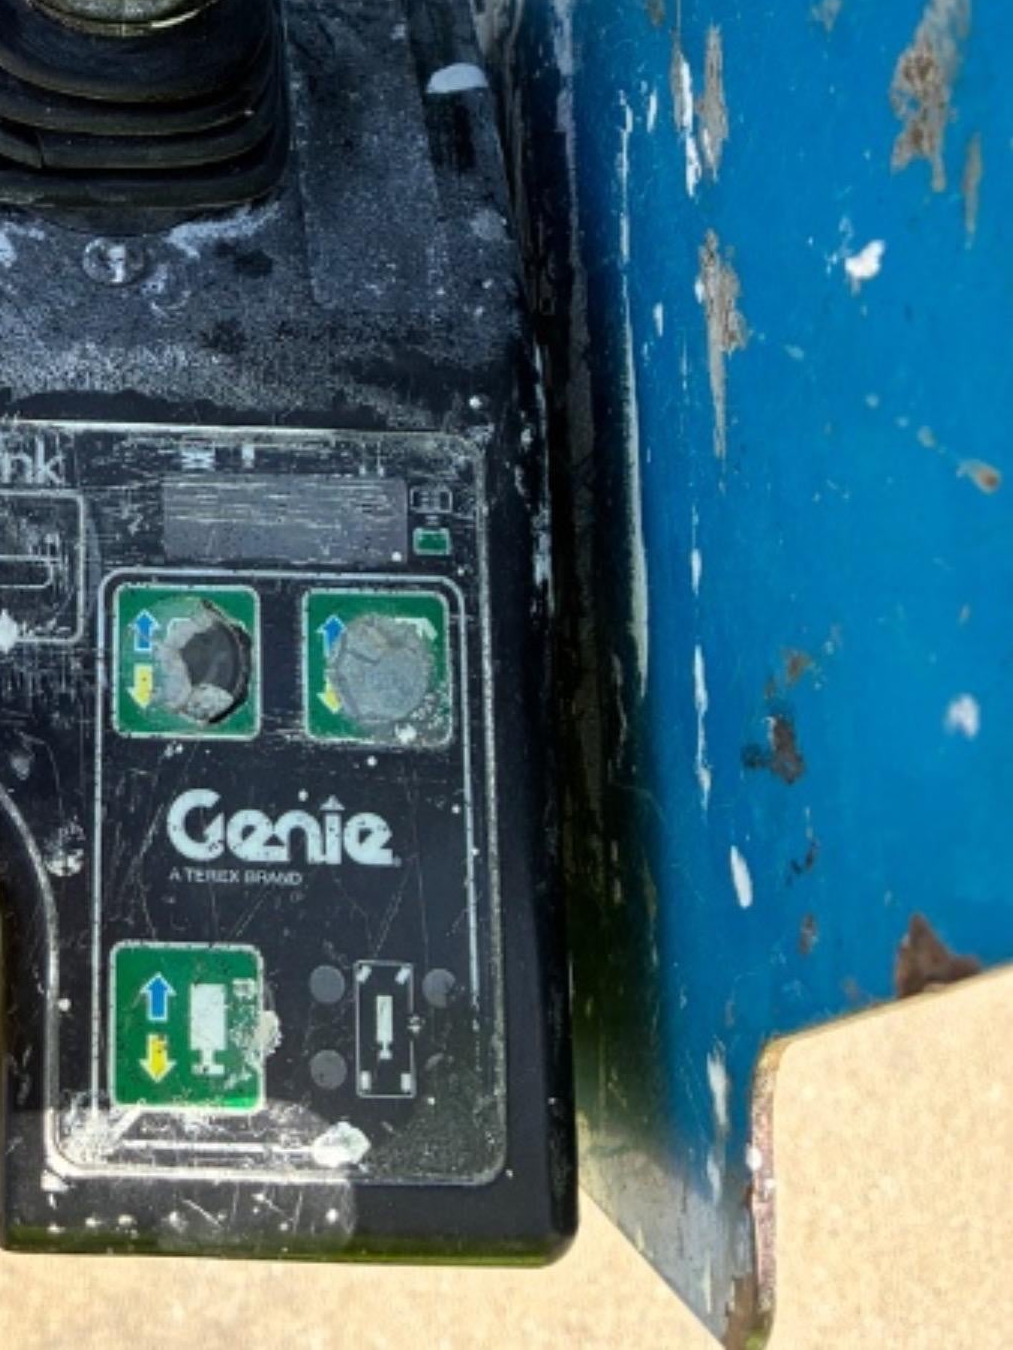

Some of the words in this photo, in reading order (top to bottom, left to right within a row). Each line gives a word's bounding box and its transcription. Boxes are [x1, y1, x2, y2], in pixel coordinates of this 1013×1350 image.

[167, 787, 394, 866] Genie
[187, 867, 239, 884] TEREX
[243, 869, 303, 886] BRAND
